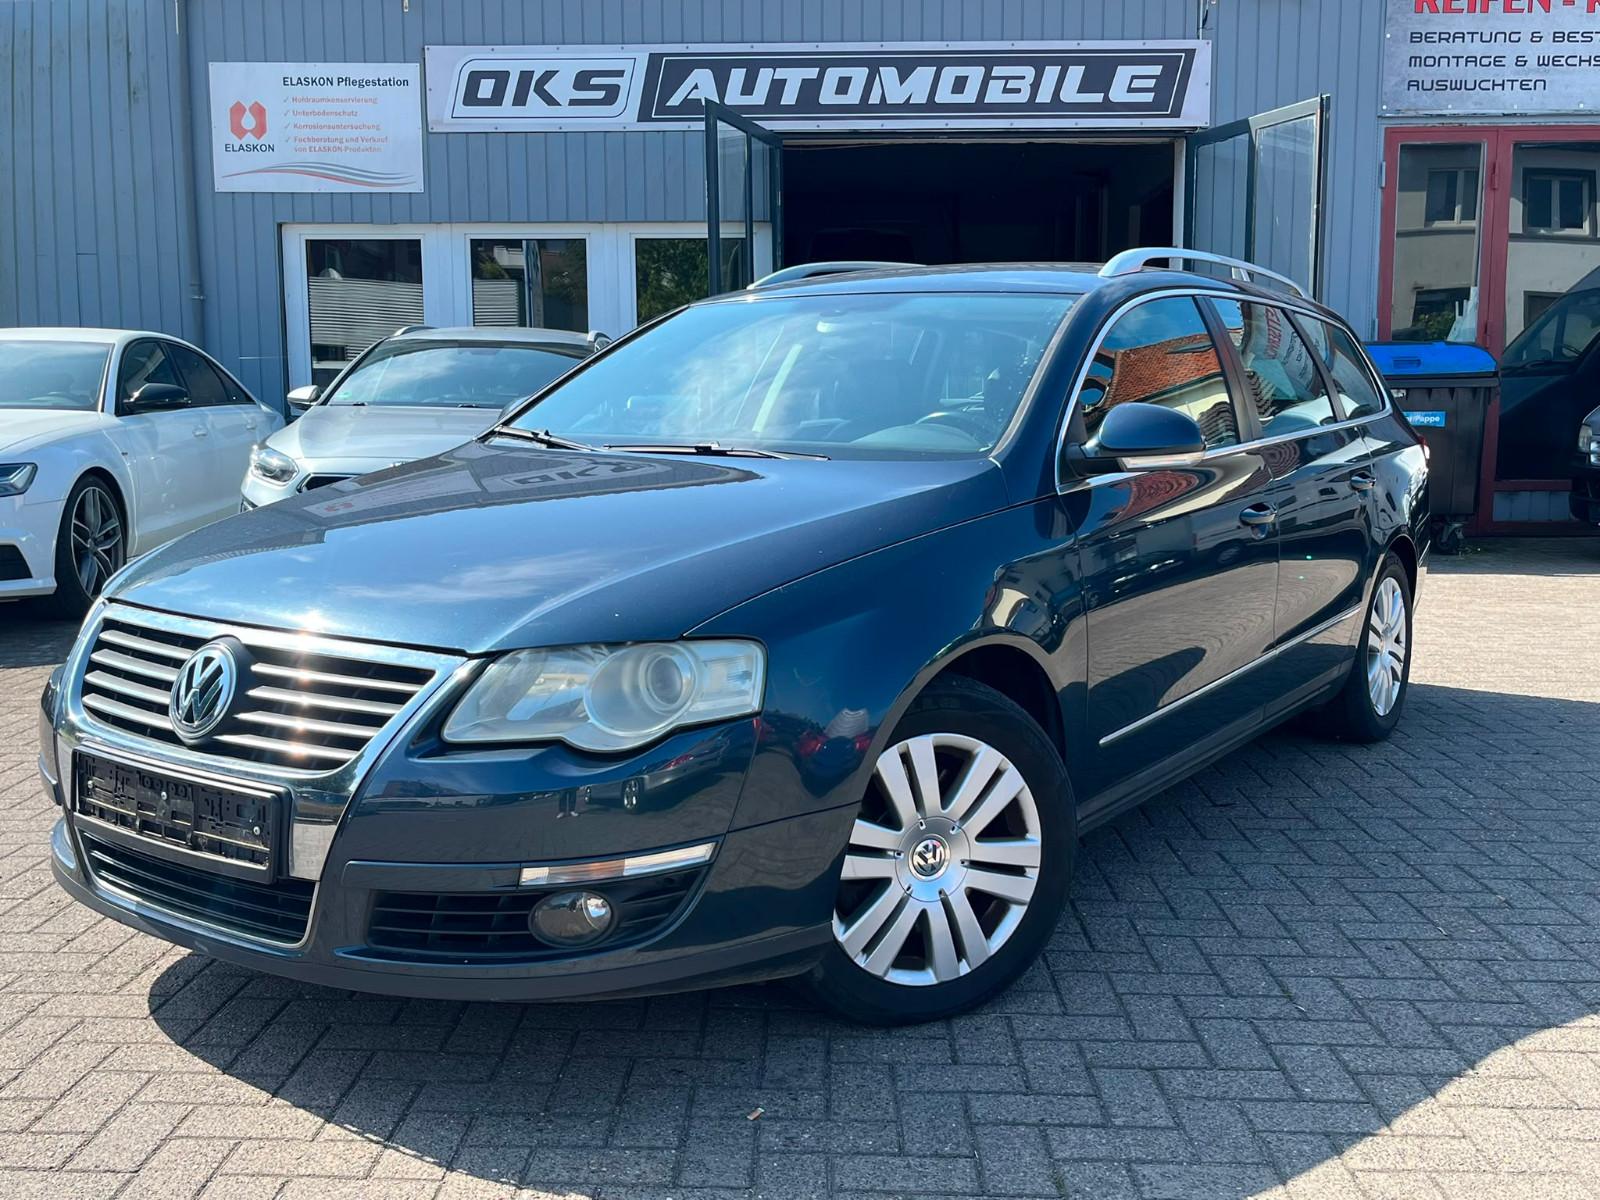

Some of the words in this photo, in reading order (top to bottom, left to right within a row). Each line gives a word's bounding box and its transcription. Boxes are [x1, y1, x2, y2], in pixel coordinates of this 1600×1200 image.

[1409, 31, 1521, 43] BERATUNG
[1530, 31, 1543, 43] &
[1408, 55, 1506, 67] MONTAGE
[1515, 55, 1528, 67] &
[282, 76, 334, 87] ELASKON
[337, 76, 409, 88] Pflegestation
[462, 70, 625, 107] OKS
[665, 65, 1164, 107] AUTOMOBILE
[1407, 79, 1547, 91] AUSWUCHTEN
[224, 144, 275, 153] ELASKON
